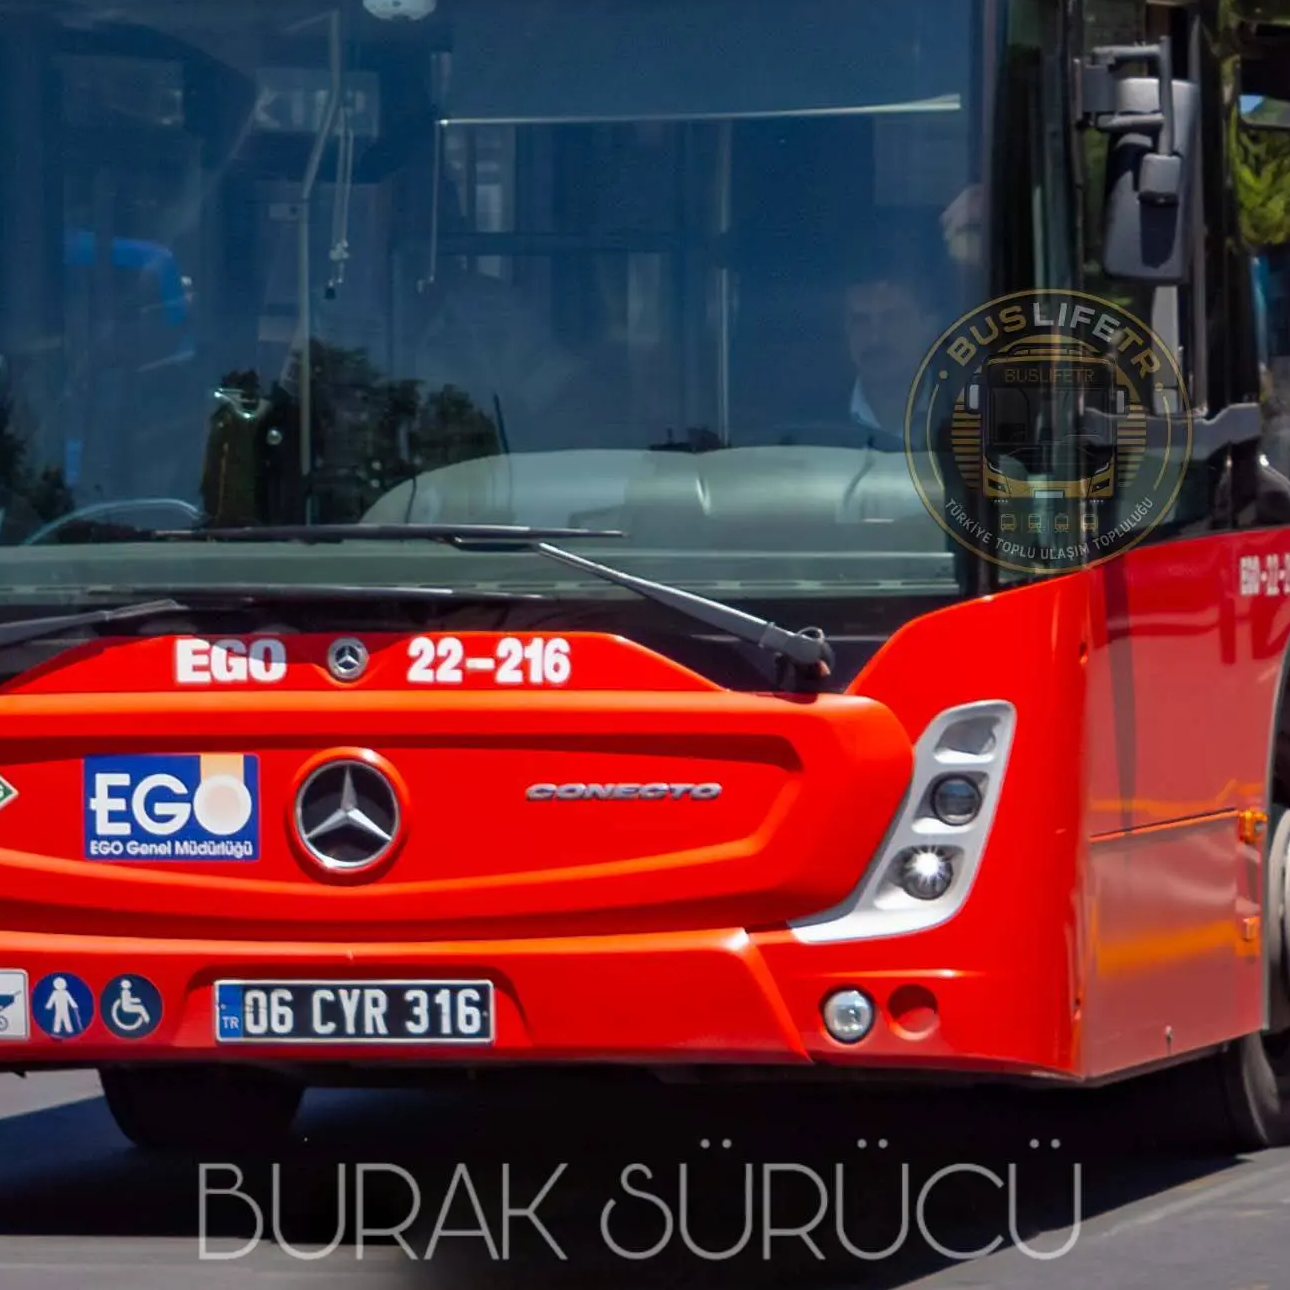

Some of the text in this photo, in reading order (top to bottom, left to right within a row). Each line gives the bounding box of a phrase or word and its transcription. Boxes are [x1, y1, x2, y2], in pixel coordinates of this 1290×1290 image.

[174, 636, 571, 685] EGO 22-216
[89, 772, 253, 836] EGO
[524, 782, 723, 801] CONECTO
[89, 839, 254, 859] EGO Genel Müdürlüğü
[221, 988, 482, 1036] TR 06 CYR 316
